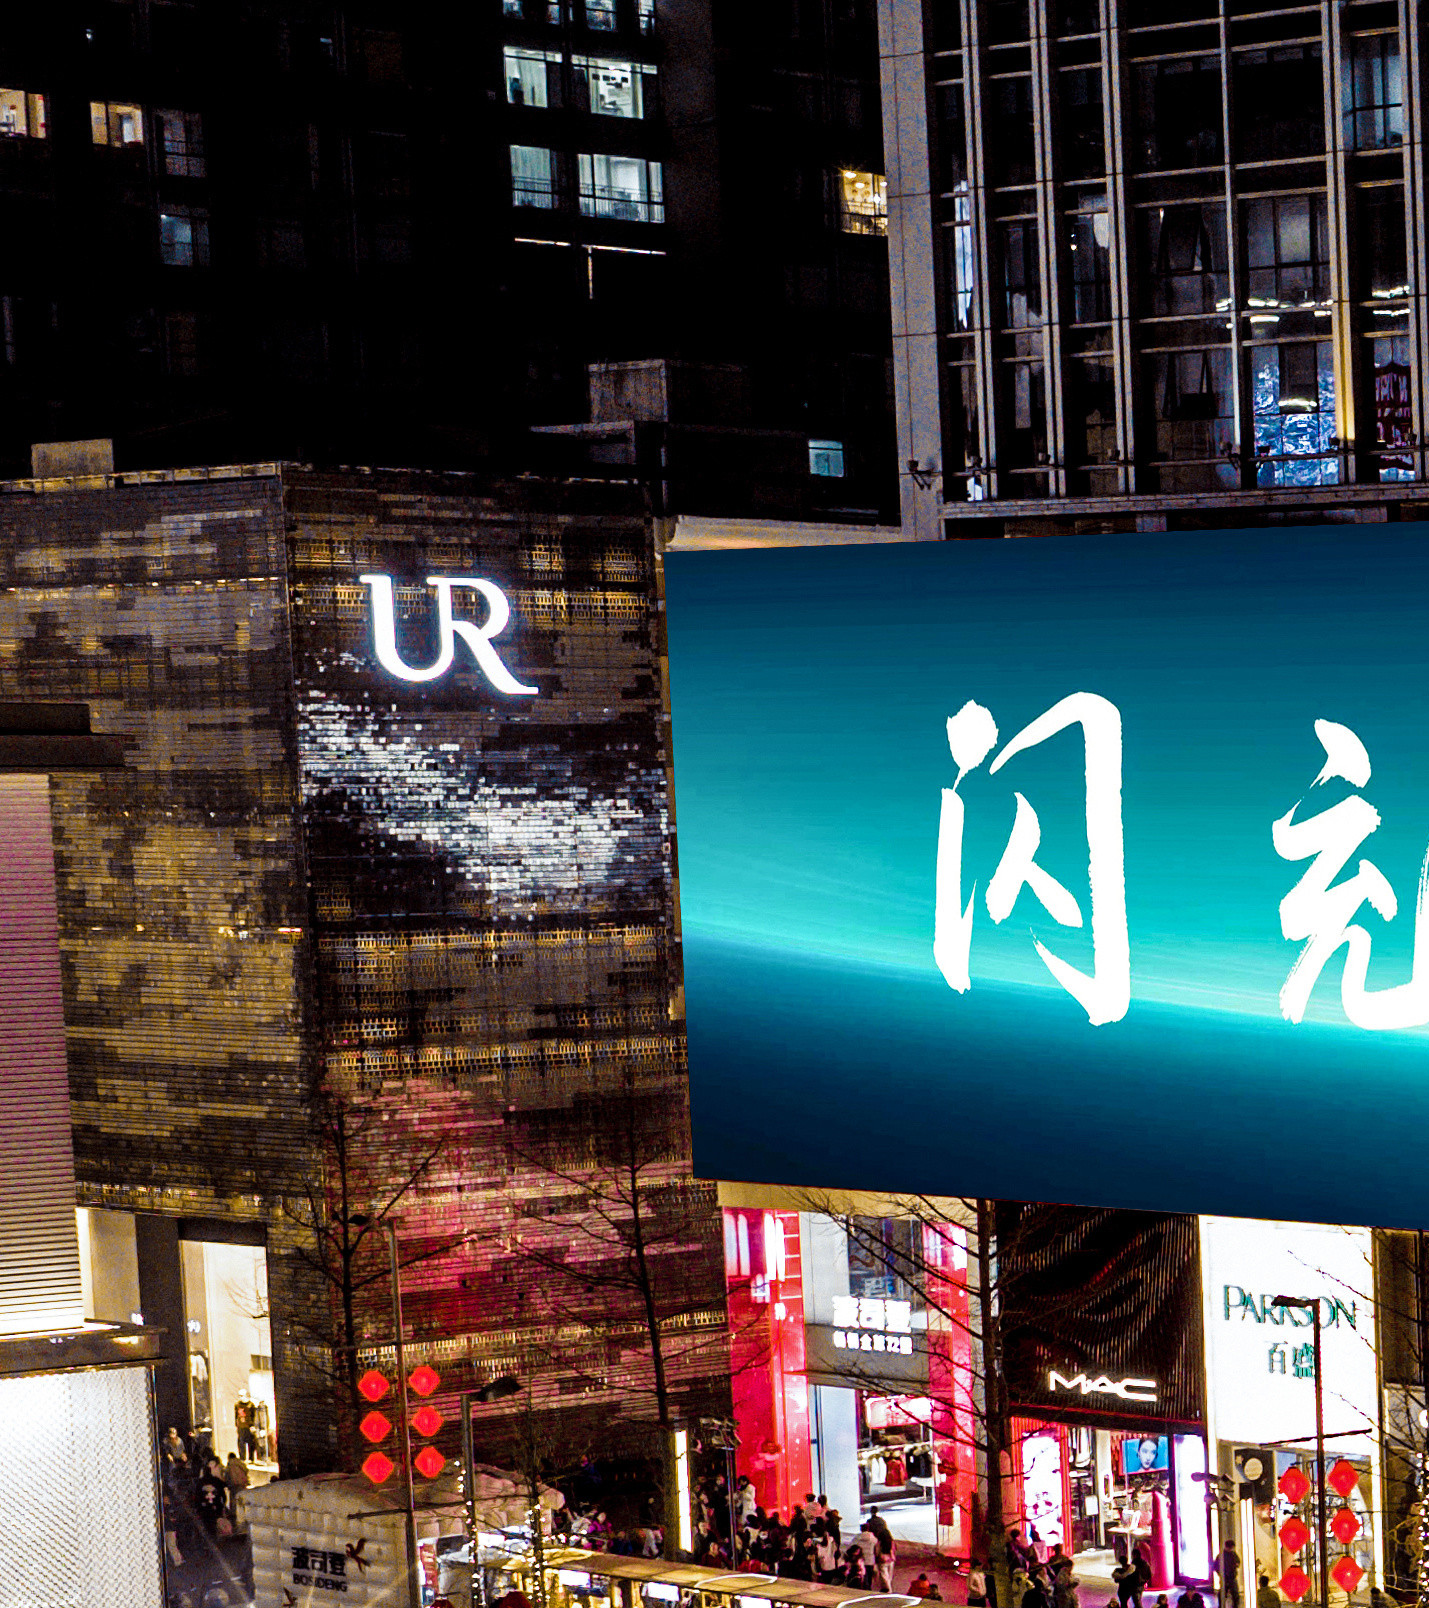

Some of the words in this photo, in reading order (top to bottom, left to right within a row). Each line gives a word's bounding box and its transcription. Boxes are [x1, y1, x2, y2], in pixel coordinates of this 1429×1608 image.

[359, 574, 538, 695] UR
[1223, 1284, 1357, 1331] PARKSON
[1263, 1340, 1316, 1379] 百盛
[291, 1547, 346, 1576] 波司登
